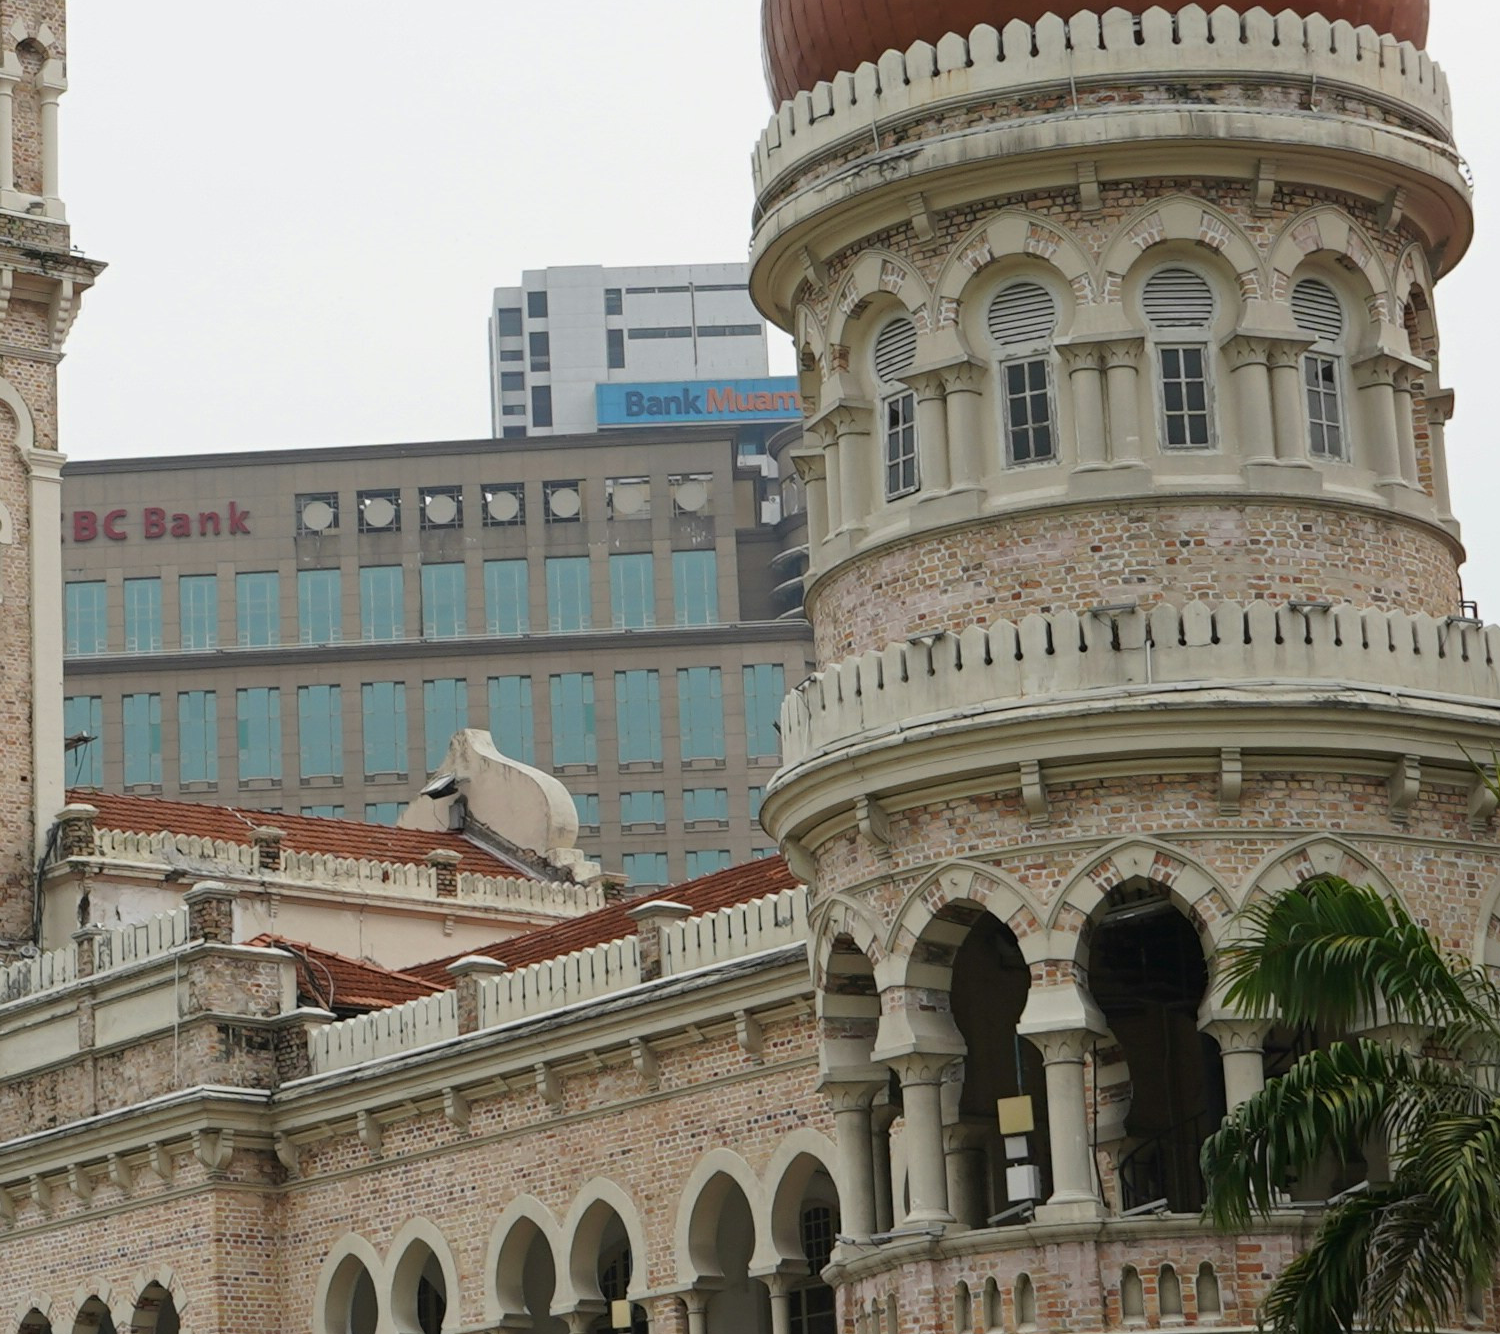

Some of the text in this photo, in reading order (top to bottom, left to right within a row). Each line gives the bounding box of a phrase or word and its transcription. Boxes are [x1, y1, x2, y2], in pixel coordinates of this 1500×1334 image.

[625, 388, 702, 416] Bank
[61, 501, 251, 543] BC Bank
